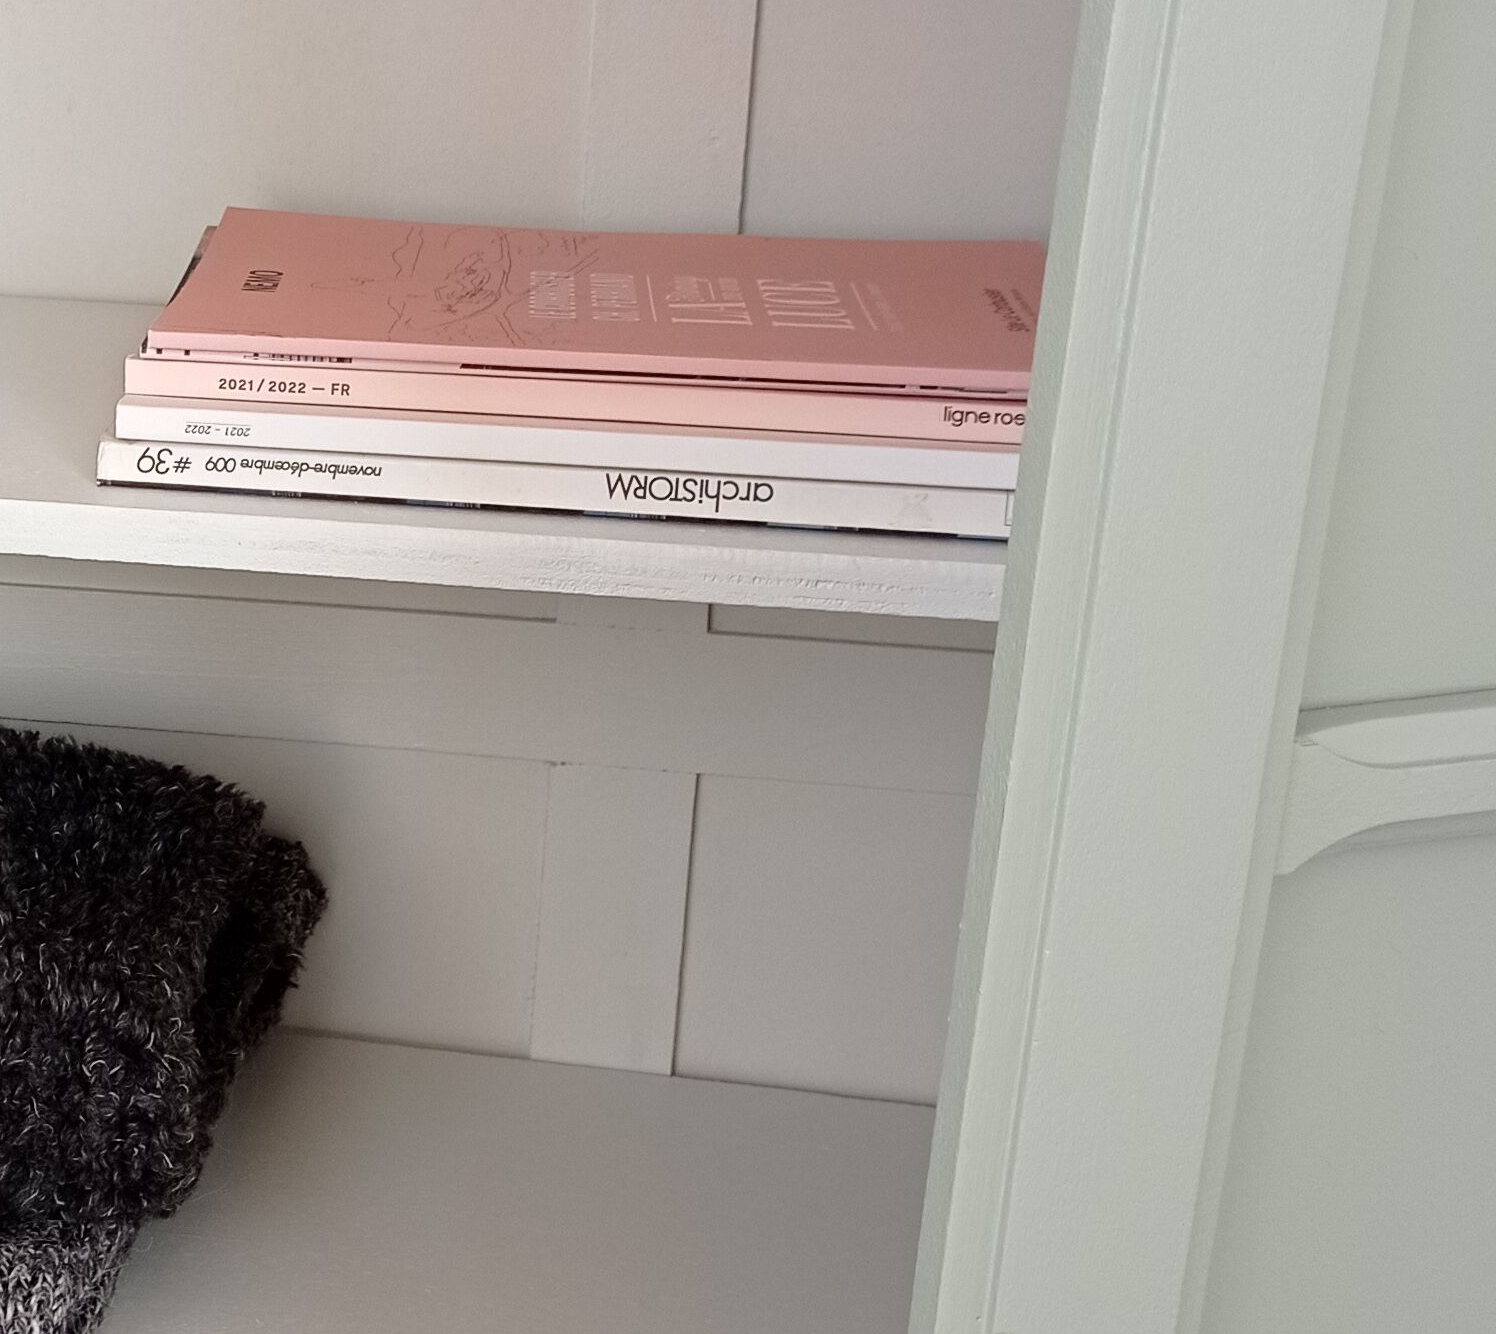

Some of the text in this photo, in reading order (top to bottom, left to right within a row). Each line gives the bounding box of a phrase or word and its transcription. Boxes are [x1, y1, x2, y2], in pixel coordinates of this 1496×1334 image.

[241, 270, 284, 292] NEMO
[331, 383, 350, 396] FR
[944, 405, 991, 427] ligne
[185, 423, 212, 435] 2022
[225, 424, 251, 437] 2021
[137, 447, 382, 480] novembre-décembre 009 #39
[606, 473, 774, 513] archiSTORM
